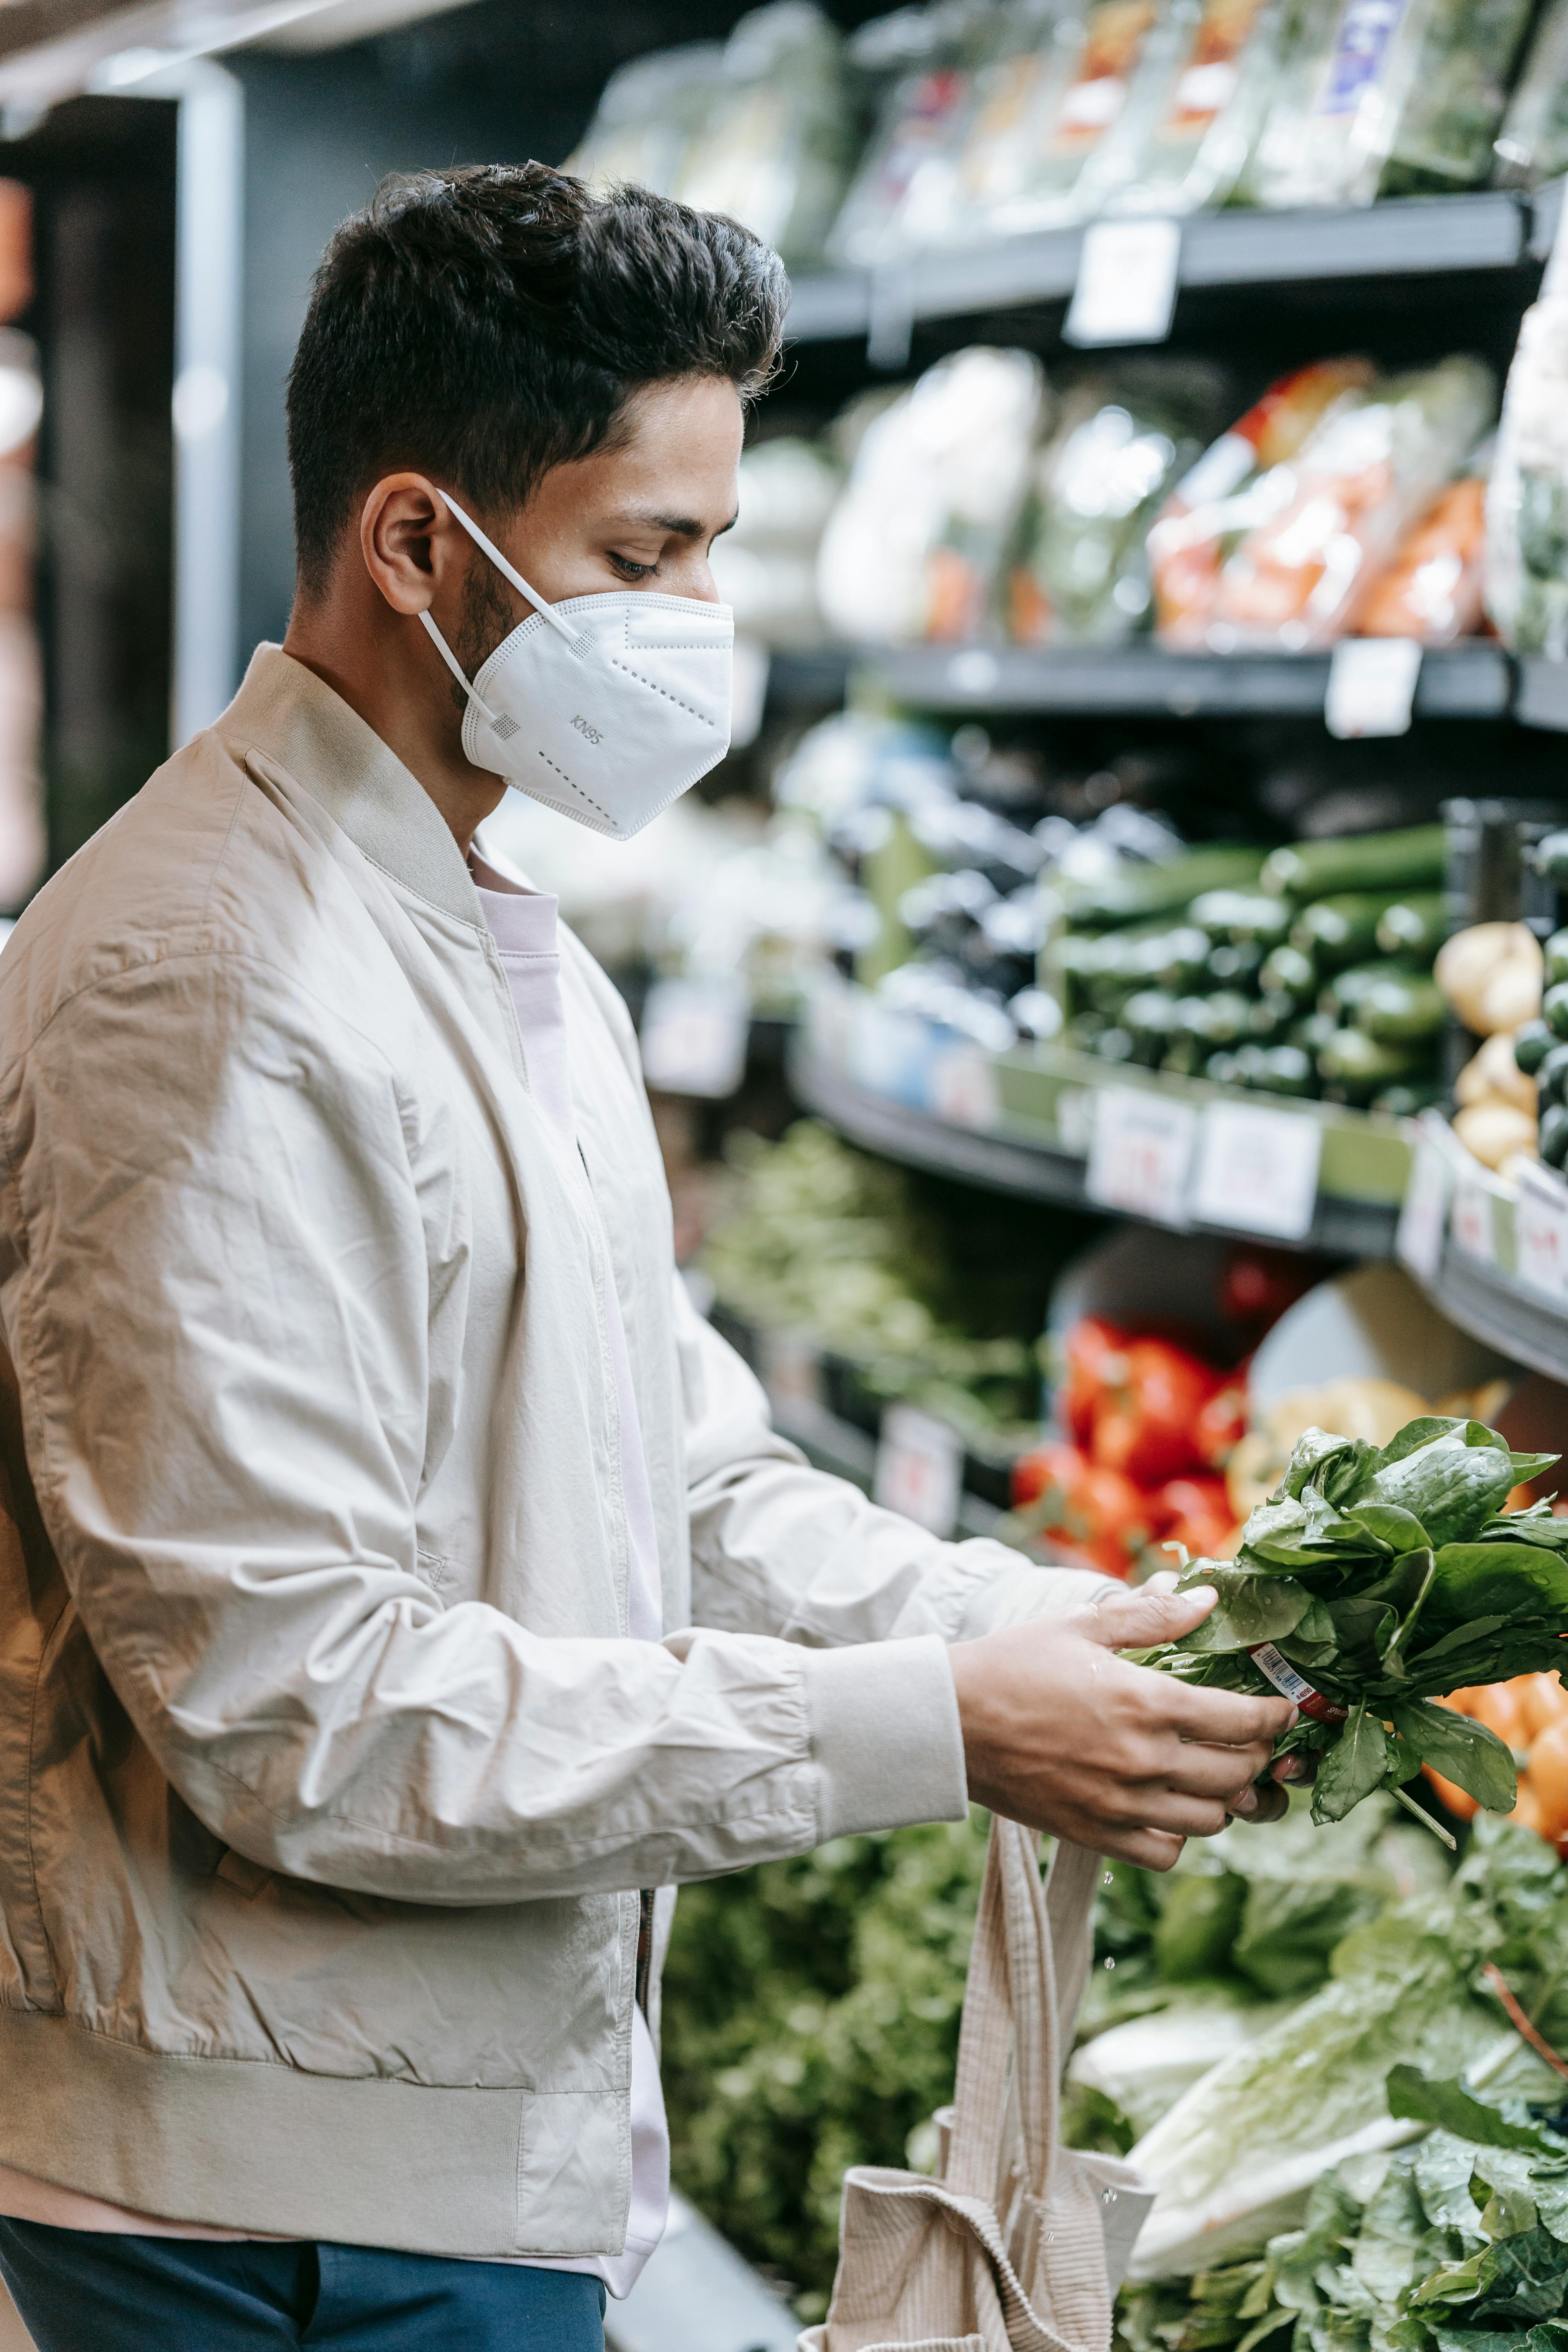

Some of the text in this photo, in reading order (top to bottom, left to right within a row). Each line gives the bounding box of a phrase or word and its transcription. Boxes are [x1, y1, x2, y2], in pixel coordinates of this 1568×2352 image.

[570, 715, 603, 744] KN95
[1296, 1687, 1312, 1700] #4090
[1327, 1707, 1348, 1717] SPINAC
